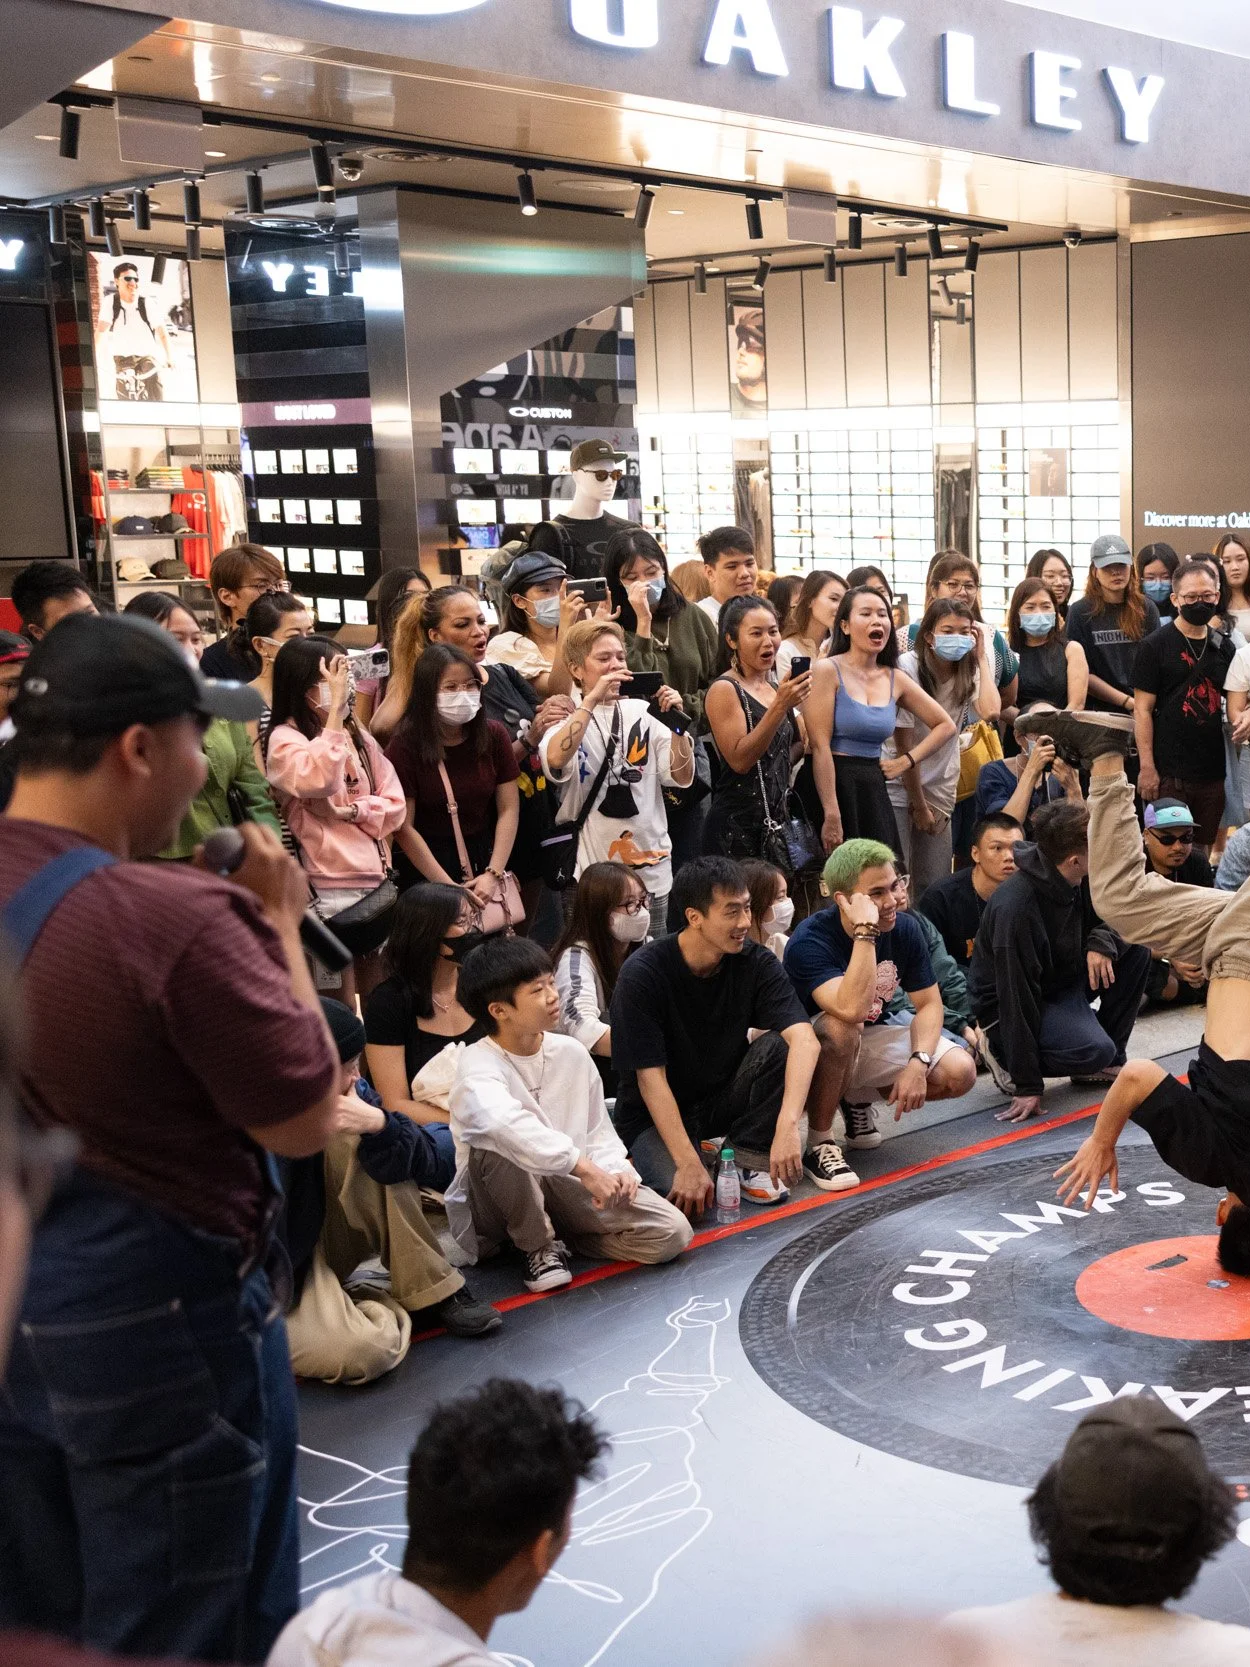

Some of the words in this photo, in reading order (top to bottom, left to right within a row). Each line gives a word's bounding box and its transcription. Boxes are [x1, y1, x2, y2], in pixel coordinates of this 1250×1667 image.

[570, 0, 1165, 144] OAKLEY
[1144, 511, 1188, 527] Discover
[1188, 516, 1215, 528] more
[1216, 514, 1227, 528] at
[892, 1181, 1186, 1305] CHAMPS
